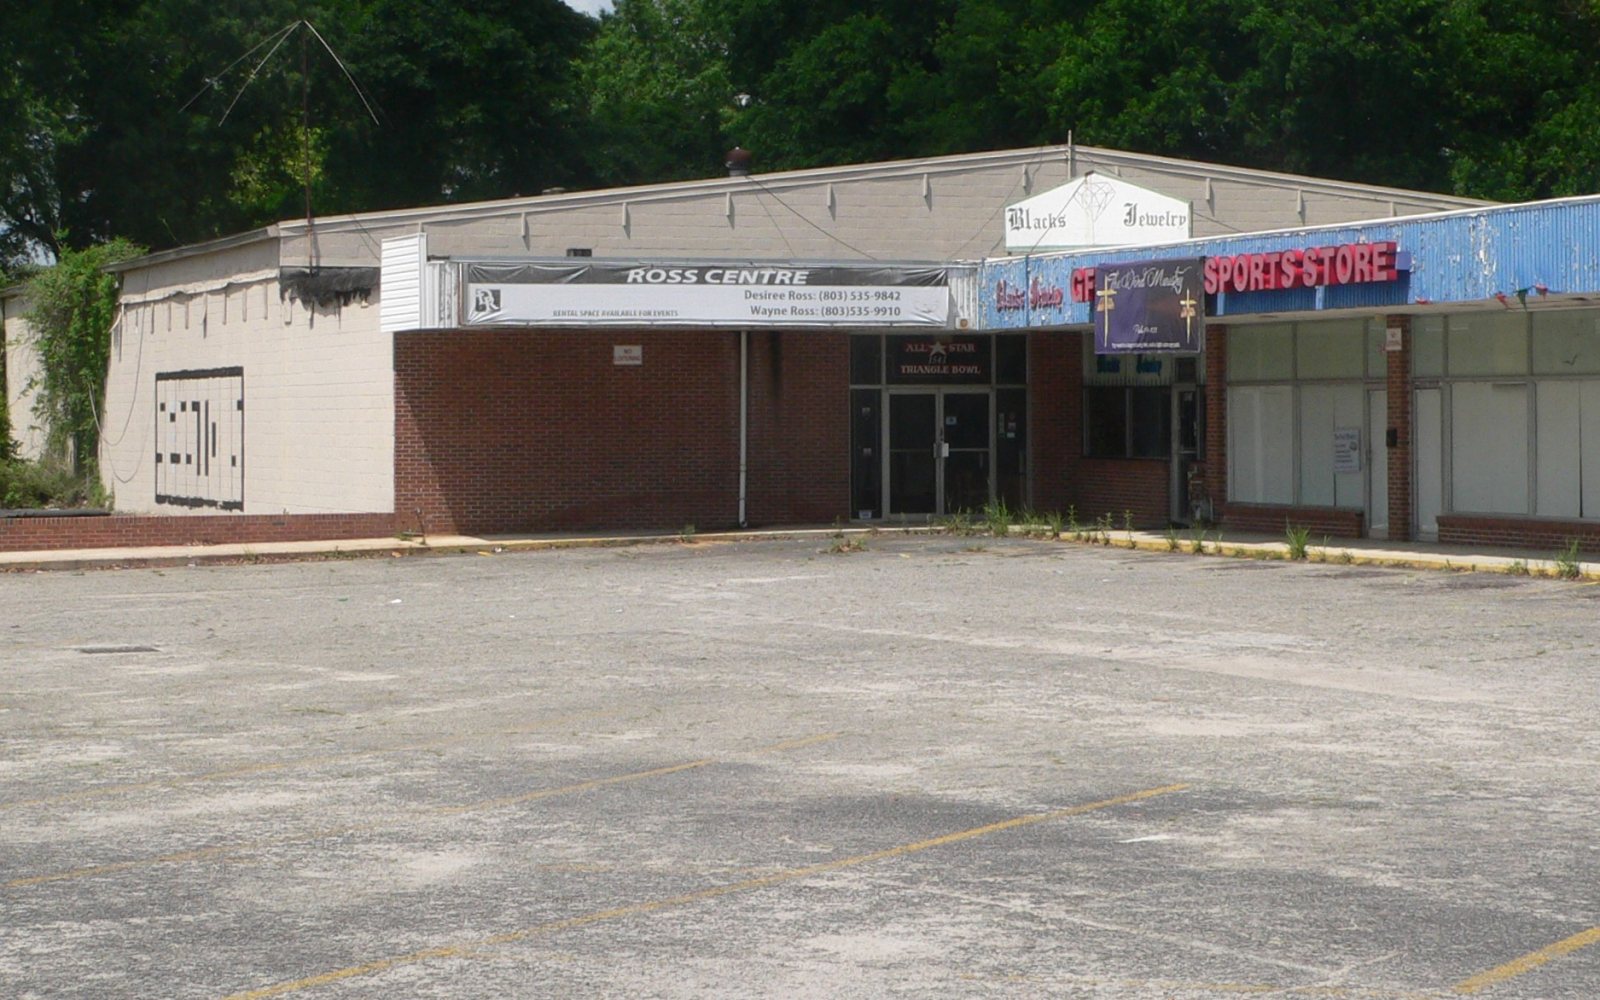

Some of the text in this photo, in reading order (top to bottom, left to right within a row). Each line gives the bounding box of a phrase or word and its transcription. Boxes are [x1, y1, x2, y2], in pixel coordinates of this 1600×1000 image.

[1007, 203, 1187, 231] Blacks Jewelry
[1203, 250, 1297, 295] SPORTS
[1302, 242, 1398, 287] STORE
[627, 269, 809, 285] ROSS CENTRE
[744, 290, 901, 302] Desiree Ross: (803) 535-9842
[750, 305, 788, 317] Wayne
[790, 306, 819, 316] Ross:
[905, 343, 976, 353] ALL STAR
[901, 365, 981, 375] TRIANGLE BOWL
